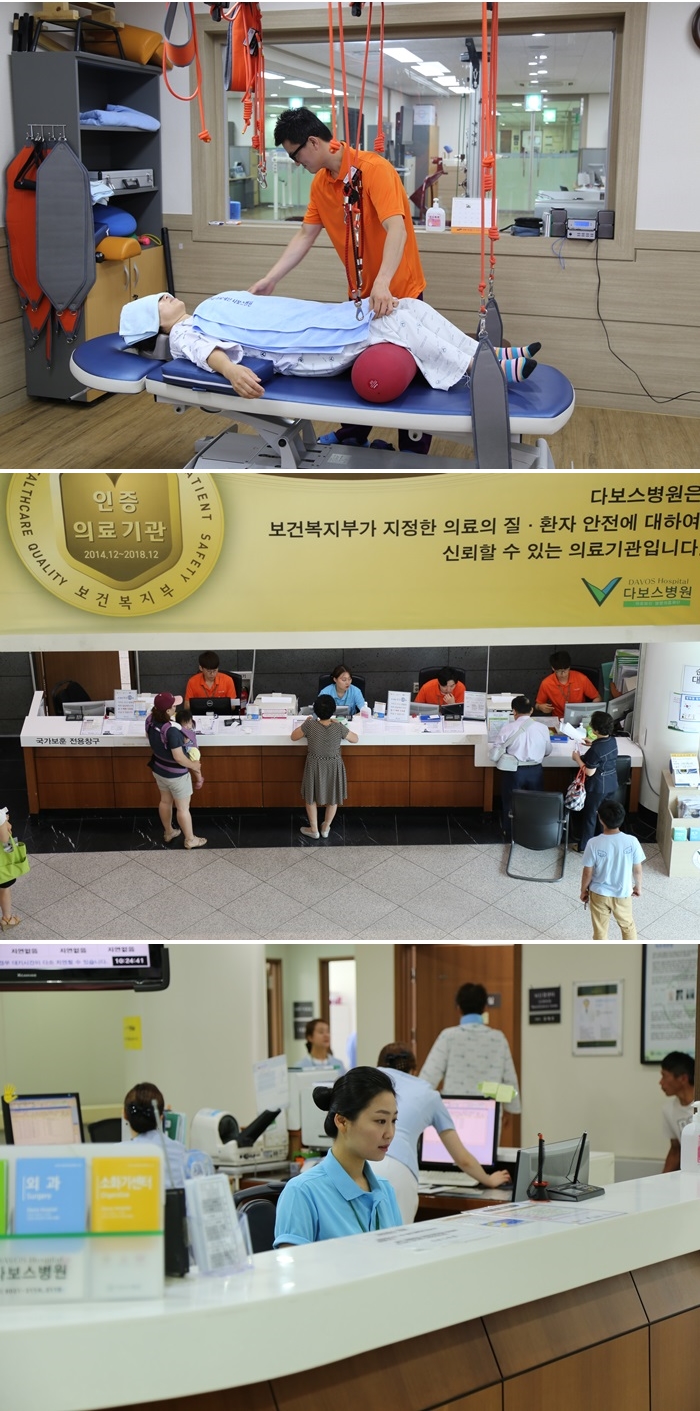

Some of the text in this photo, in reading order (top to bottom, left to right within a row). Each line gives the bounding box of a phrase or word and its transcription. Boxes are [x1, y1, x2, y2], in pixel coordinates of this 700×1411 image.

[92, 490, 140, 514] 인증
[591, 485, 700, 505] 다보스병원은
[73, 520, 167, 543] 의료기관
[268, 512, 700, 538] 보건복지부가 지정한 의료의 질 환자 안전에 대하여
[84, 550, 159, 560] 2014.12~2018.12
[180, 533, 211, 584] SAFETY
[442, 543, 497, 561] 신뢰할
[502, 543, 521, 560] 수
[527, 542, 563, 560] 있는
[27, 542, 68, 586] QUALITY
[623, 585, 693, 600] 다보스병원
[628, 577, 689, 587] DAVOS Hospital
[74, 583, 175, 610] 보건복지부
[36, 737, 100, 745] 국가보훈 전용창구
